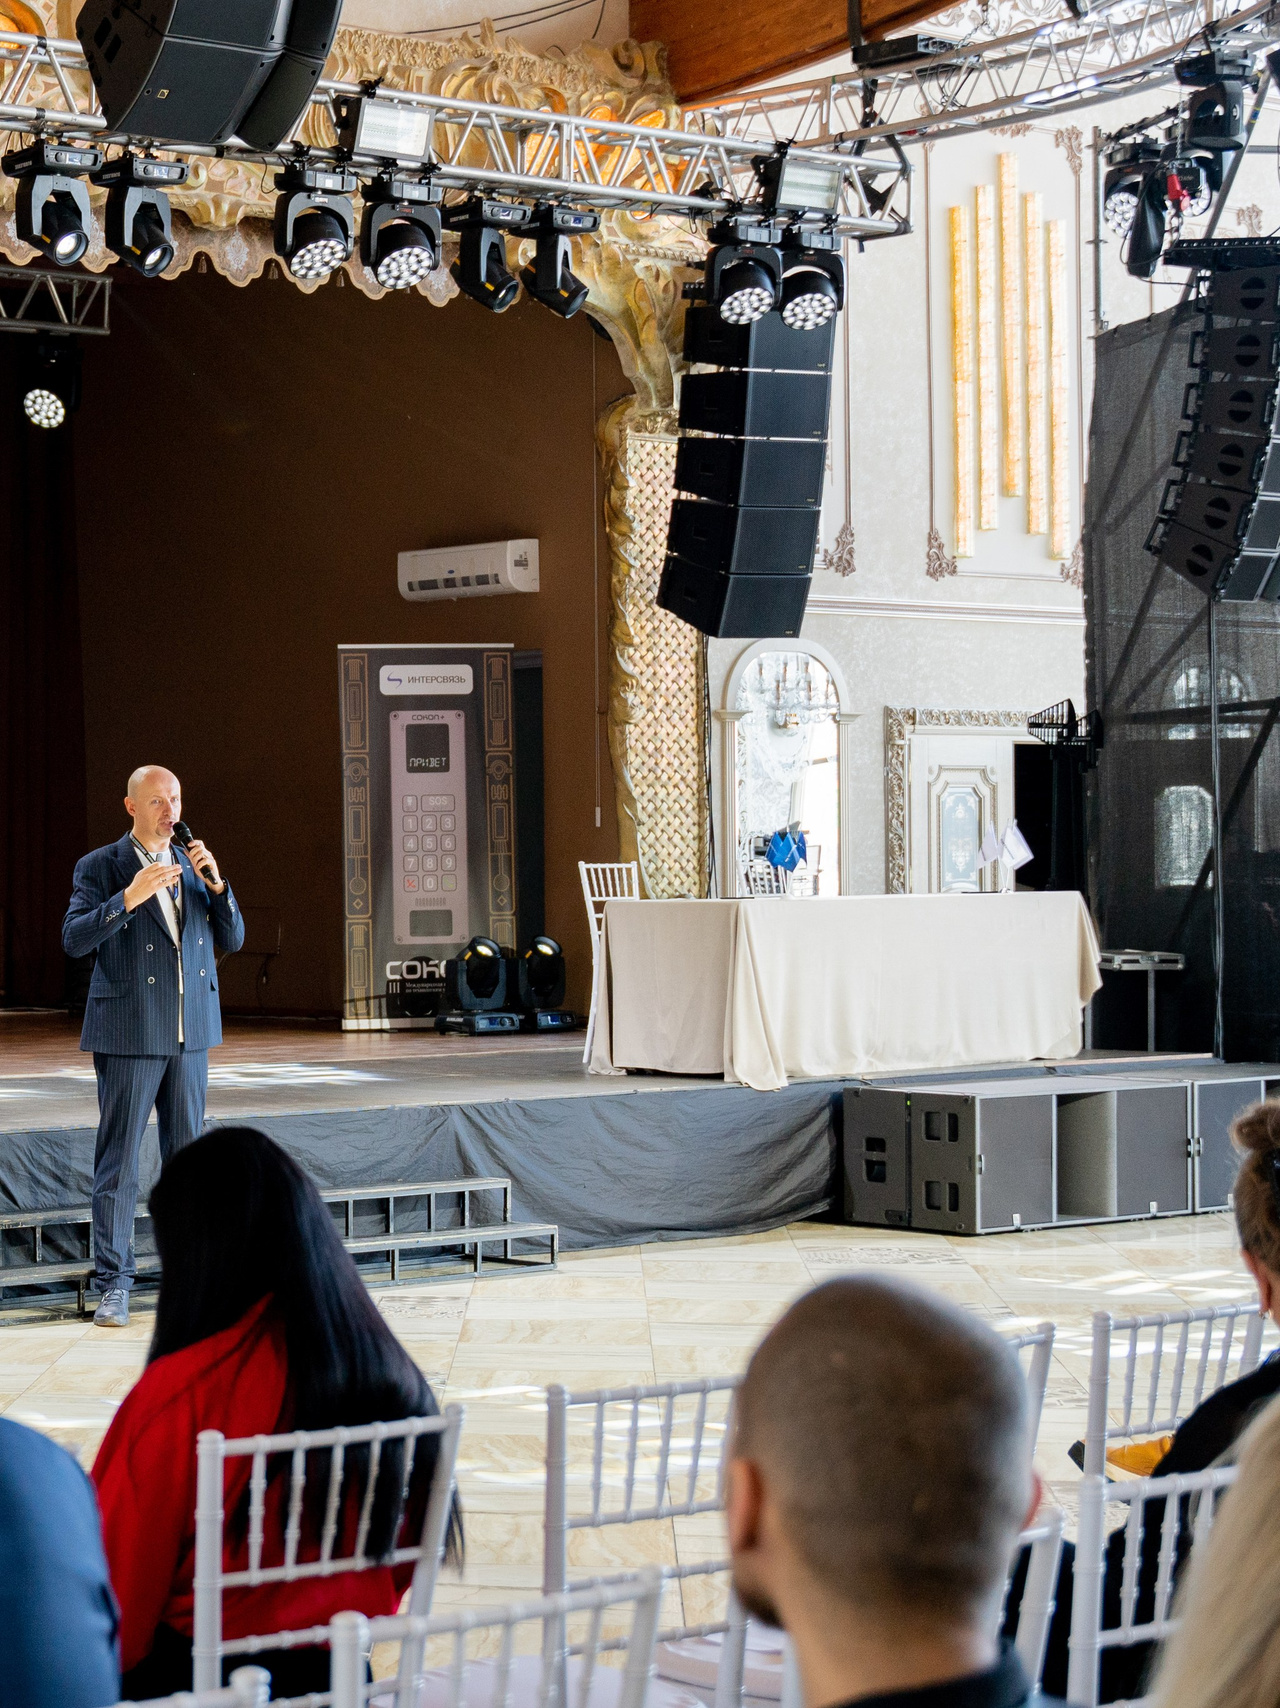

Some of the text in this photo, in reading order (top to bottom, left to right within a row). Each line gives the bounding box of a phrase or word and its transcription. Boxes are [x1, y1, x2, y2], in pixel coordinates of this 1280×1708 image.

[407, 675, 467, 685] ИНТЕРСВЯЗЬ
[409, 757, 447, 768] ПРИВЕТ
[428, 796, 448, 806] SOS
[425, 818, 433, 828] 2
[444, 818, 451, 828] 3
[406, 837, 452, 849] 4 5 6
[407, 857, 453, 869] 7 8 9
